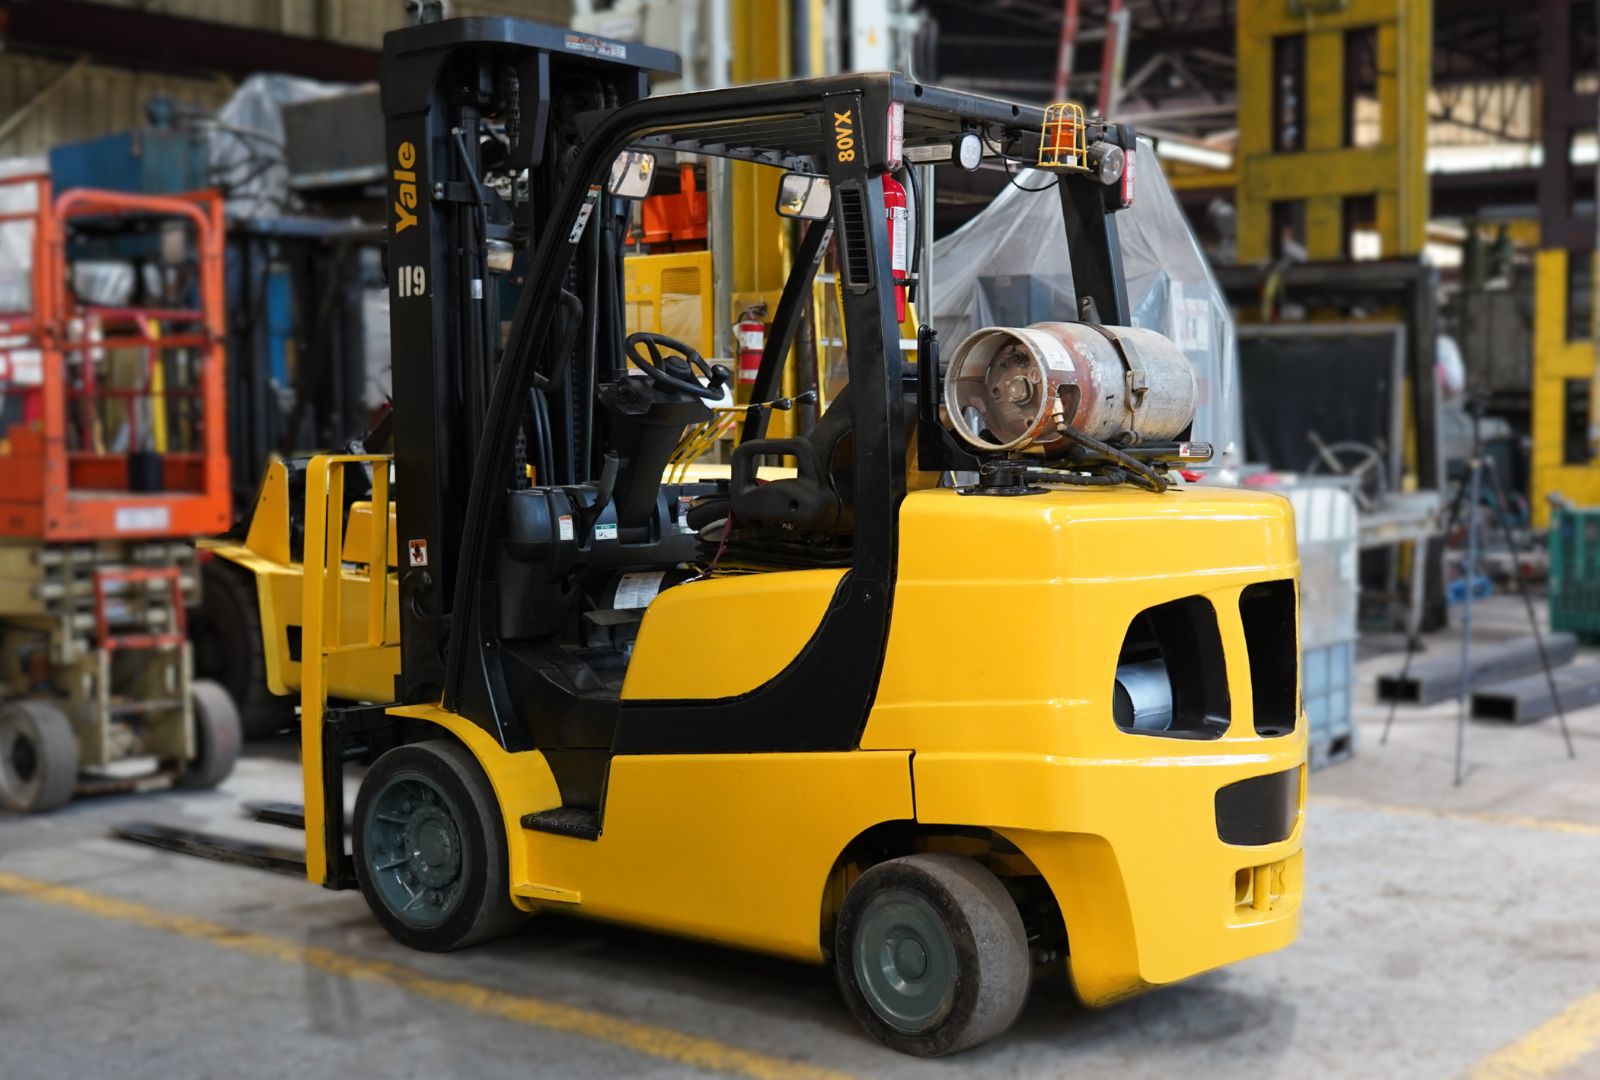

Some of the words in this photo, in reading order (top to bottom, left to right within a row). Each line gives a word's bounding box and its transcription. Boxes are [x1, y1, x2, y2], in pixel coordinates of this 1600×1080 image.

[834, 110, 855, 162] 80VX
[394, 142, 418, 233] Yale
[398, 265, 426, 297] 119
